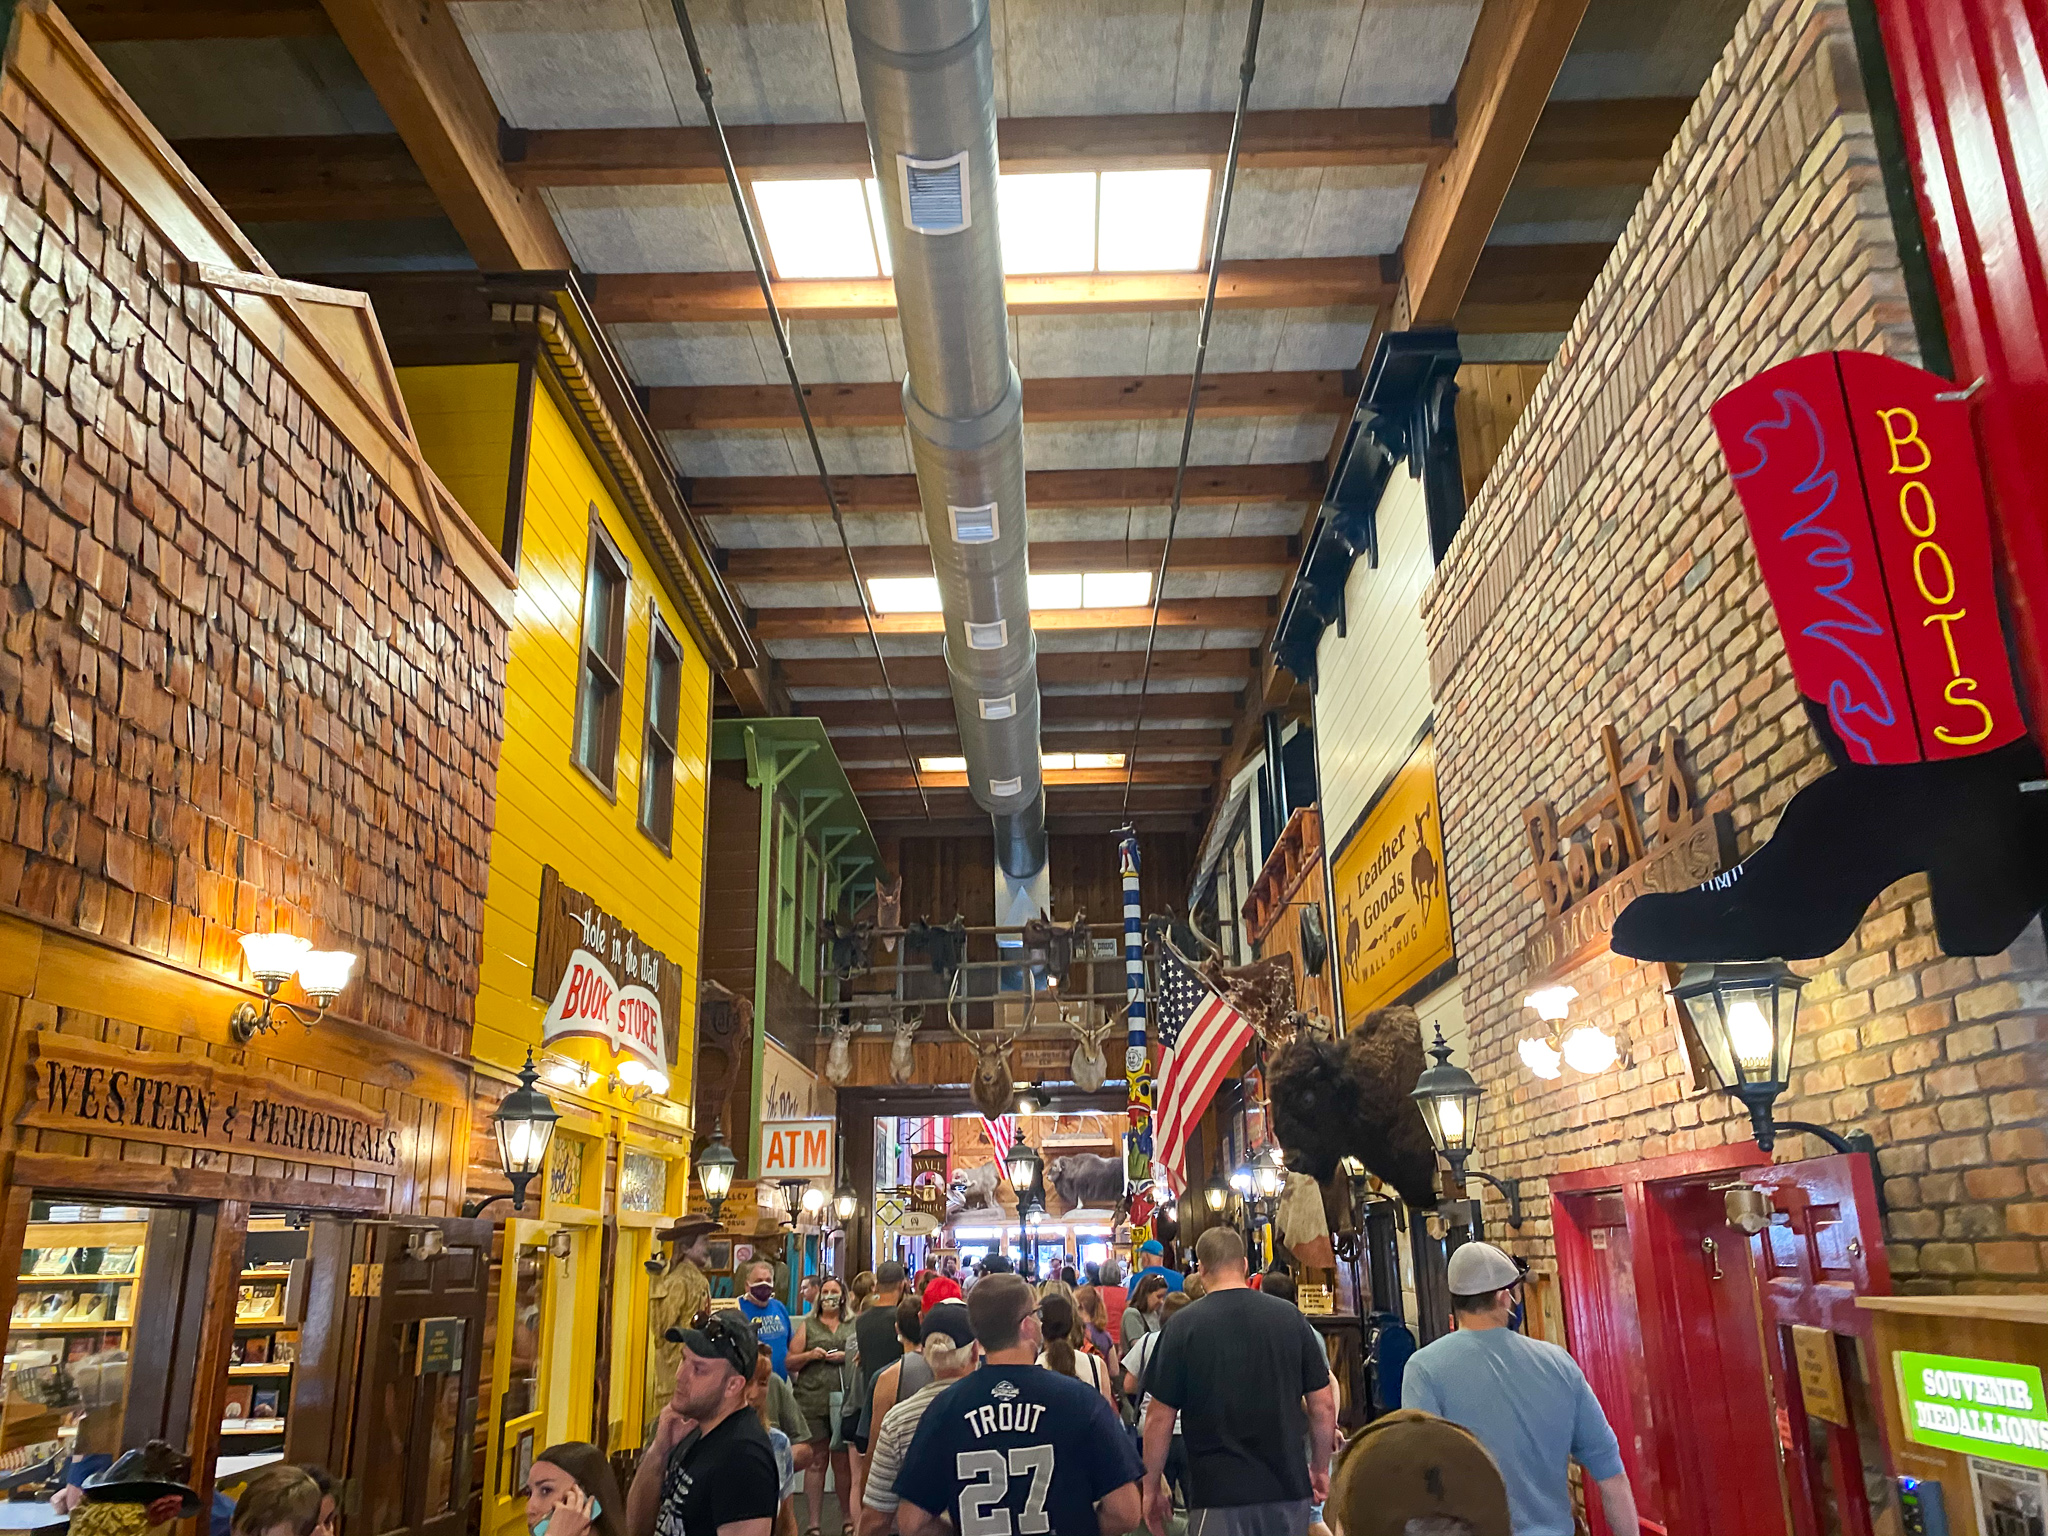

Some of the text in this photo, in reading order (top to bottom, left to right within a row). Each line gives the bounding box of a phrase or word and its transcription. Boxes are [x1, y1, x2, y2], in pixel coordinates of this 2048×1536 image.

[1876, 407, 1993, 745] BOOTS
[1357, 824, 1406, 900] Leather
[1363, 871, 1405, 930] Goods
[569, 908, 660, 993] Hole in the Wall
[1361, 923, 1418, 984] WALL DRUG
[560, 964, 658, 1056] BOOK STORE
[46, 1059, 397, 1166] WESTERN & PERIODICALS
[766, 1129, 827, 1169] ATM
[914, 1160, 943, 1172] WALL
[915, 1202, 942, 1213] DRUG
[1922, 1368, 2033, 1410] SOUVENIR
[964, 1402, 1046, 1438] TROUT
[1914, 1400, 2048, 1451] MEDALLIONS
[956, 1444, 1055, 1536] 27
